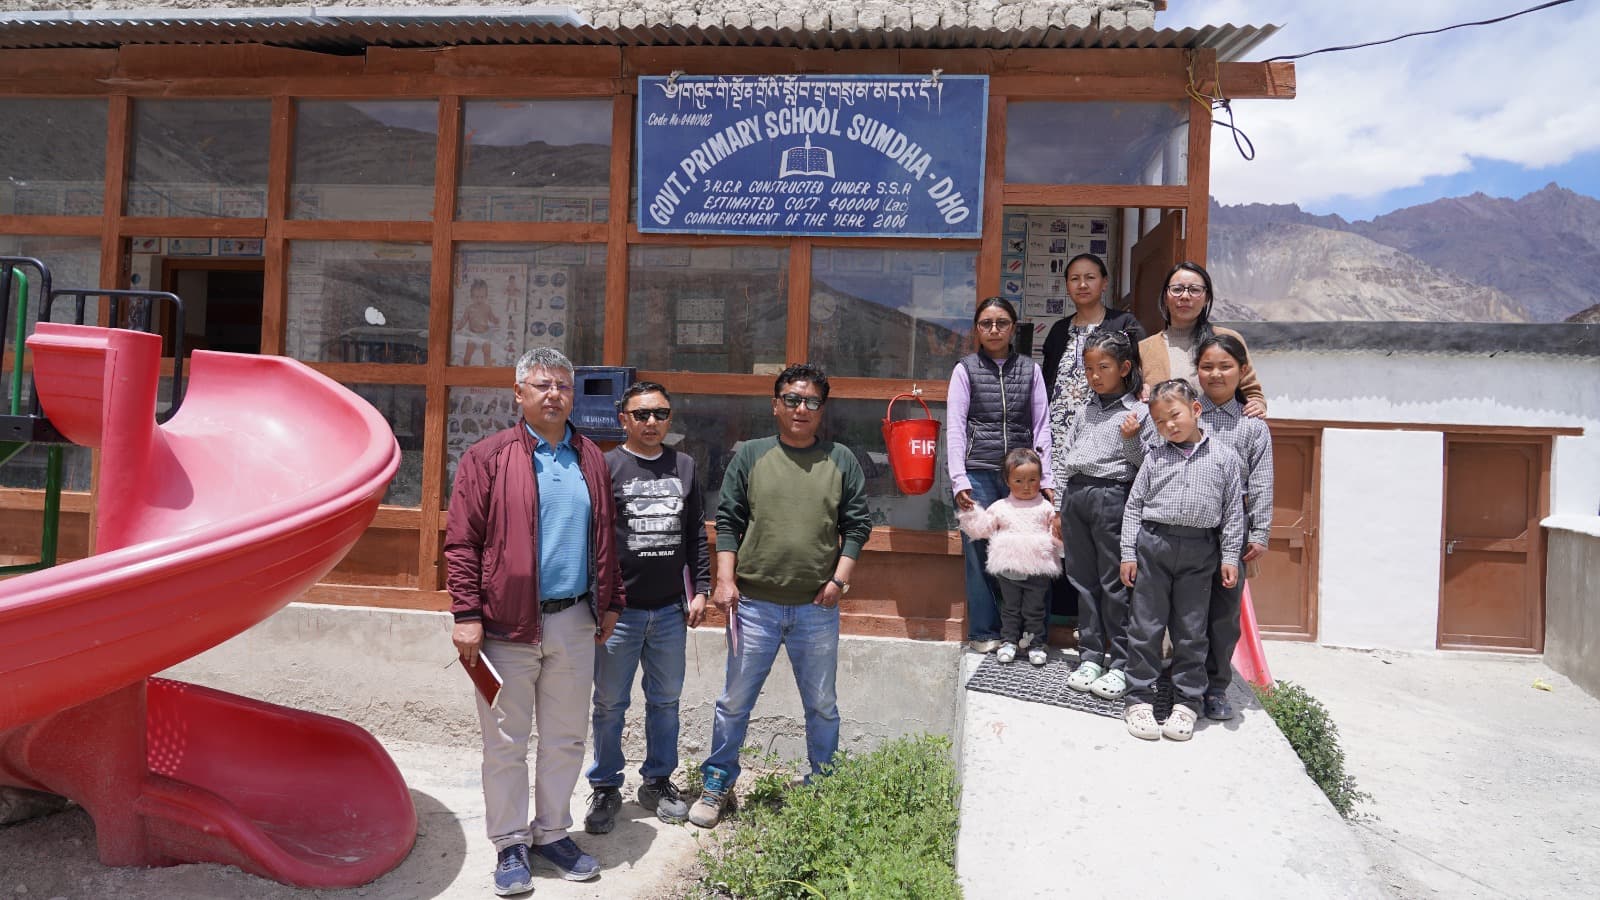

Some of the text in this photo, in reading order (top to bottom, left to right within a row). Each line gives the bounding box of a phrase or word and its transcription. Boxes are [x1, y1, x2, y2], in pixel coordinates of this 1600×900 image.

[648, 113, 668, 126] Code
[650, 171, 691, 225] GOVT.
[680, 115, 763, 184] PRIMARY
[765, 107, 841, 138] SCHOOL
[749, 180, 824, 194] CONSTRUCTED
[831, 181, 870, 194] UNDER
[704, 196, 775, 210] ESTIMATED
[785, 197, 818, 210] COST
[828, 197, 880, 210] 400000
[684, 212, 909, 227] COMMENCEMENT OF THE YEAR 2006
